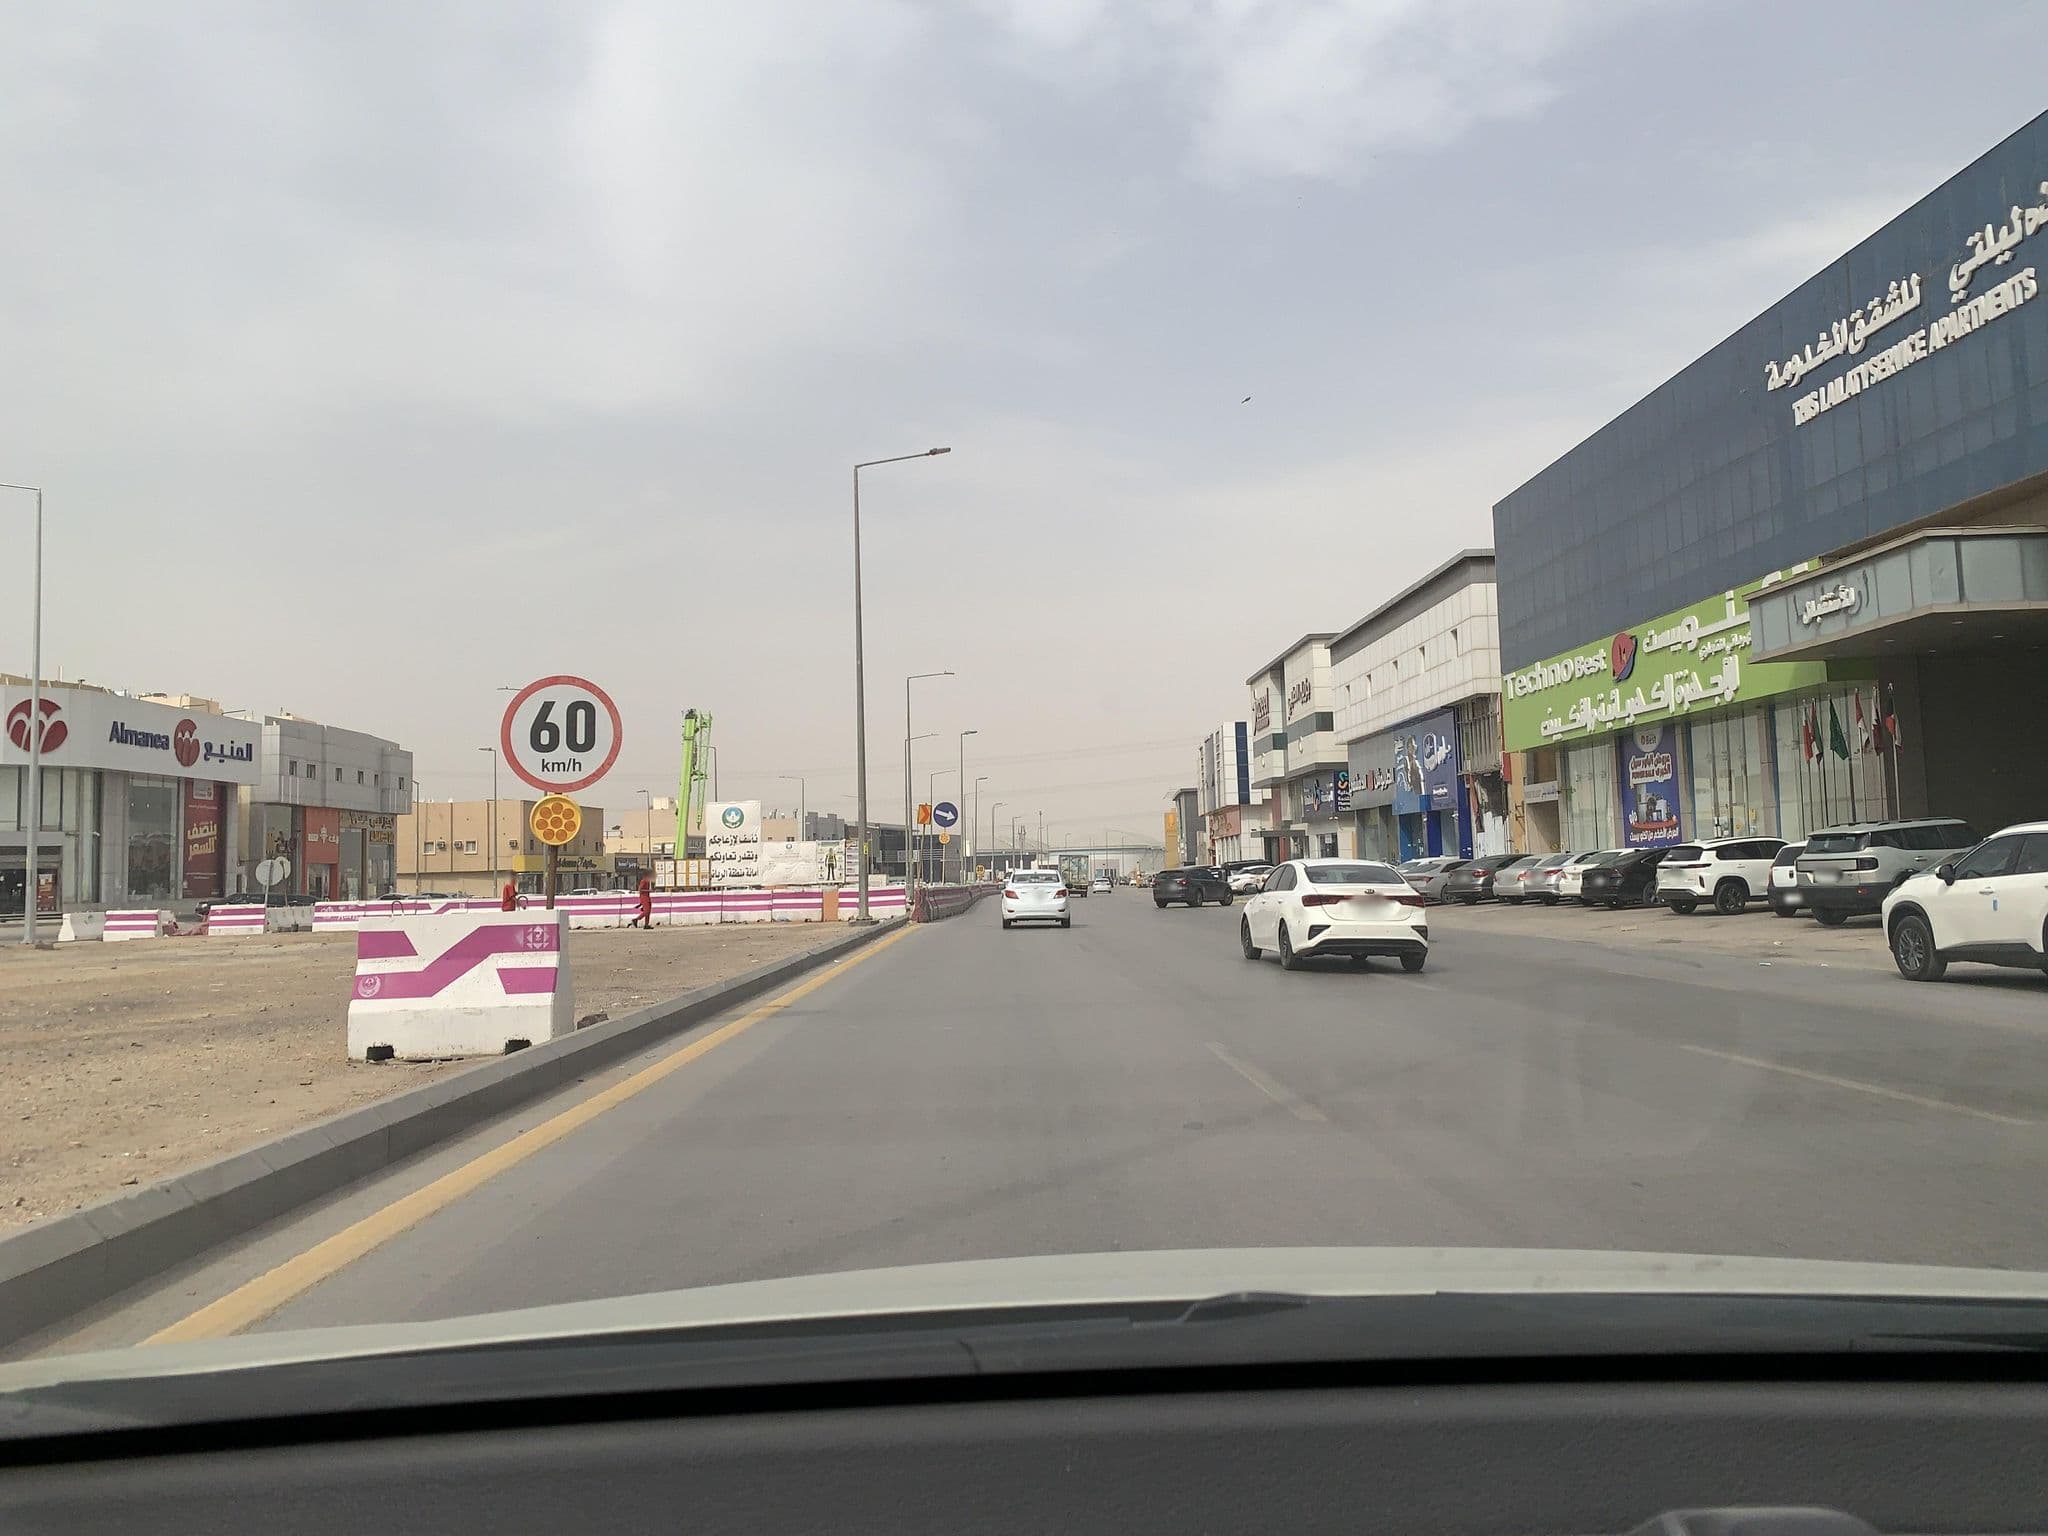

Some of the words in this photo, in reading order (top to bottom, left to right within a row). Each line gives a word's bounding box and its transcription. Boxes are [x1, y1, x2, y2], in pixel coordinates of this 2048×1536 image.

[1948, 205, 2024, 304] ليلتي
[1848, 272, 1921, 354] للشقق
[1868, 329, 1927, 385] SERVICE
[1928, 267, 2038, 354] APARTMENTS
[1502, 658, 1574, 700] Techno
[1573, 648, 1607, 679] Best
[1597, 674, 1675, 730] الكهربائية
[109, 720, 170, 751] Almanea
[530, 700, 596, 753] 60
[203, 740, 253, 763] المنيع
[541, 758, 582, 773] km/h
[187, 820, 218, 840] بنصف
[709, 834, 738, 847] لإزعاجكم
[739, 834, 758, 844] نأسف
[188, 836, 216, 861] السعر
[710, 851, 737, 863] تعاونكم
[737, 850, 758, 863] ونقدر
[728, 867, 745, 878] منطقة
